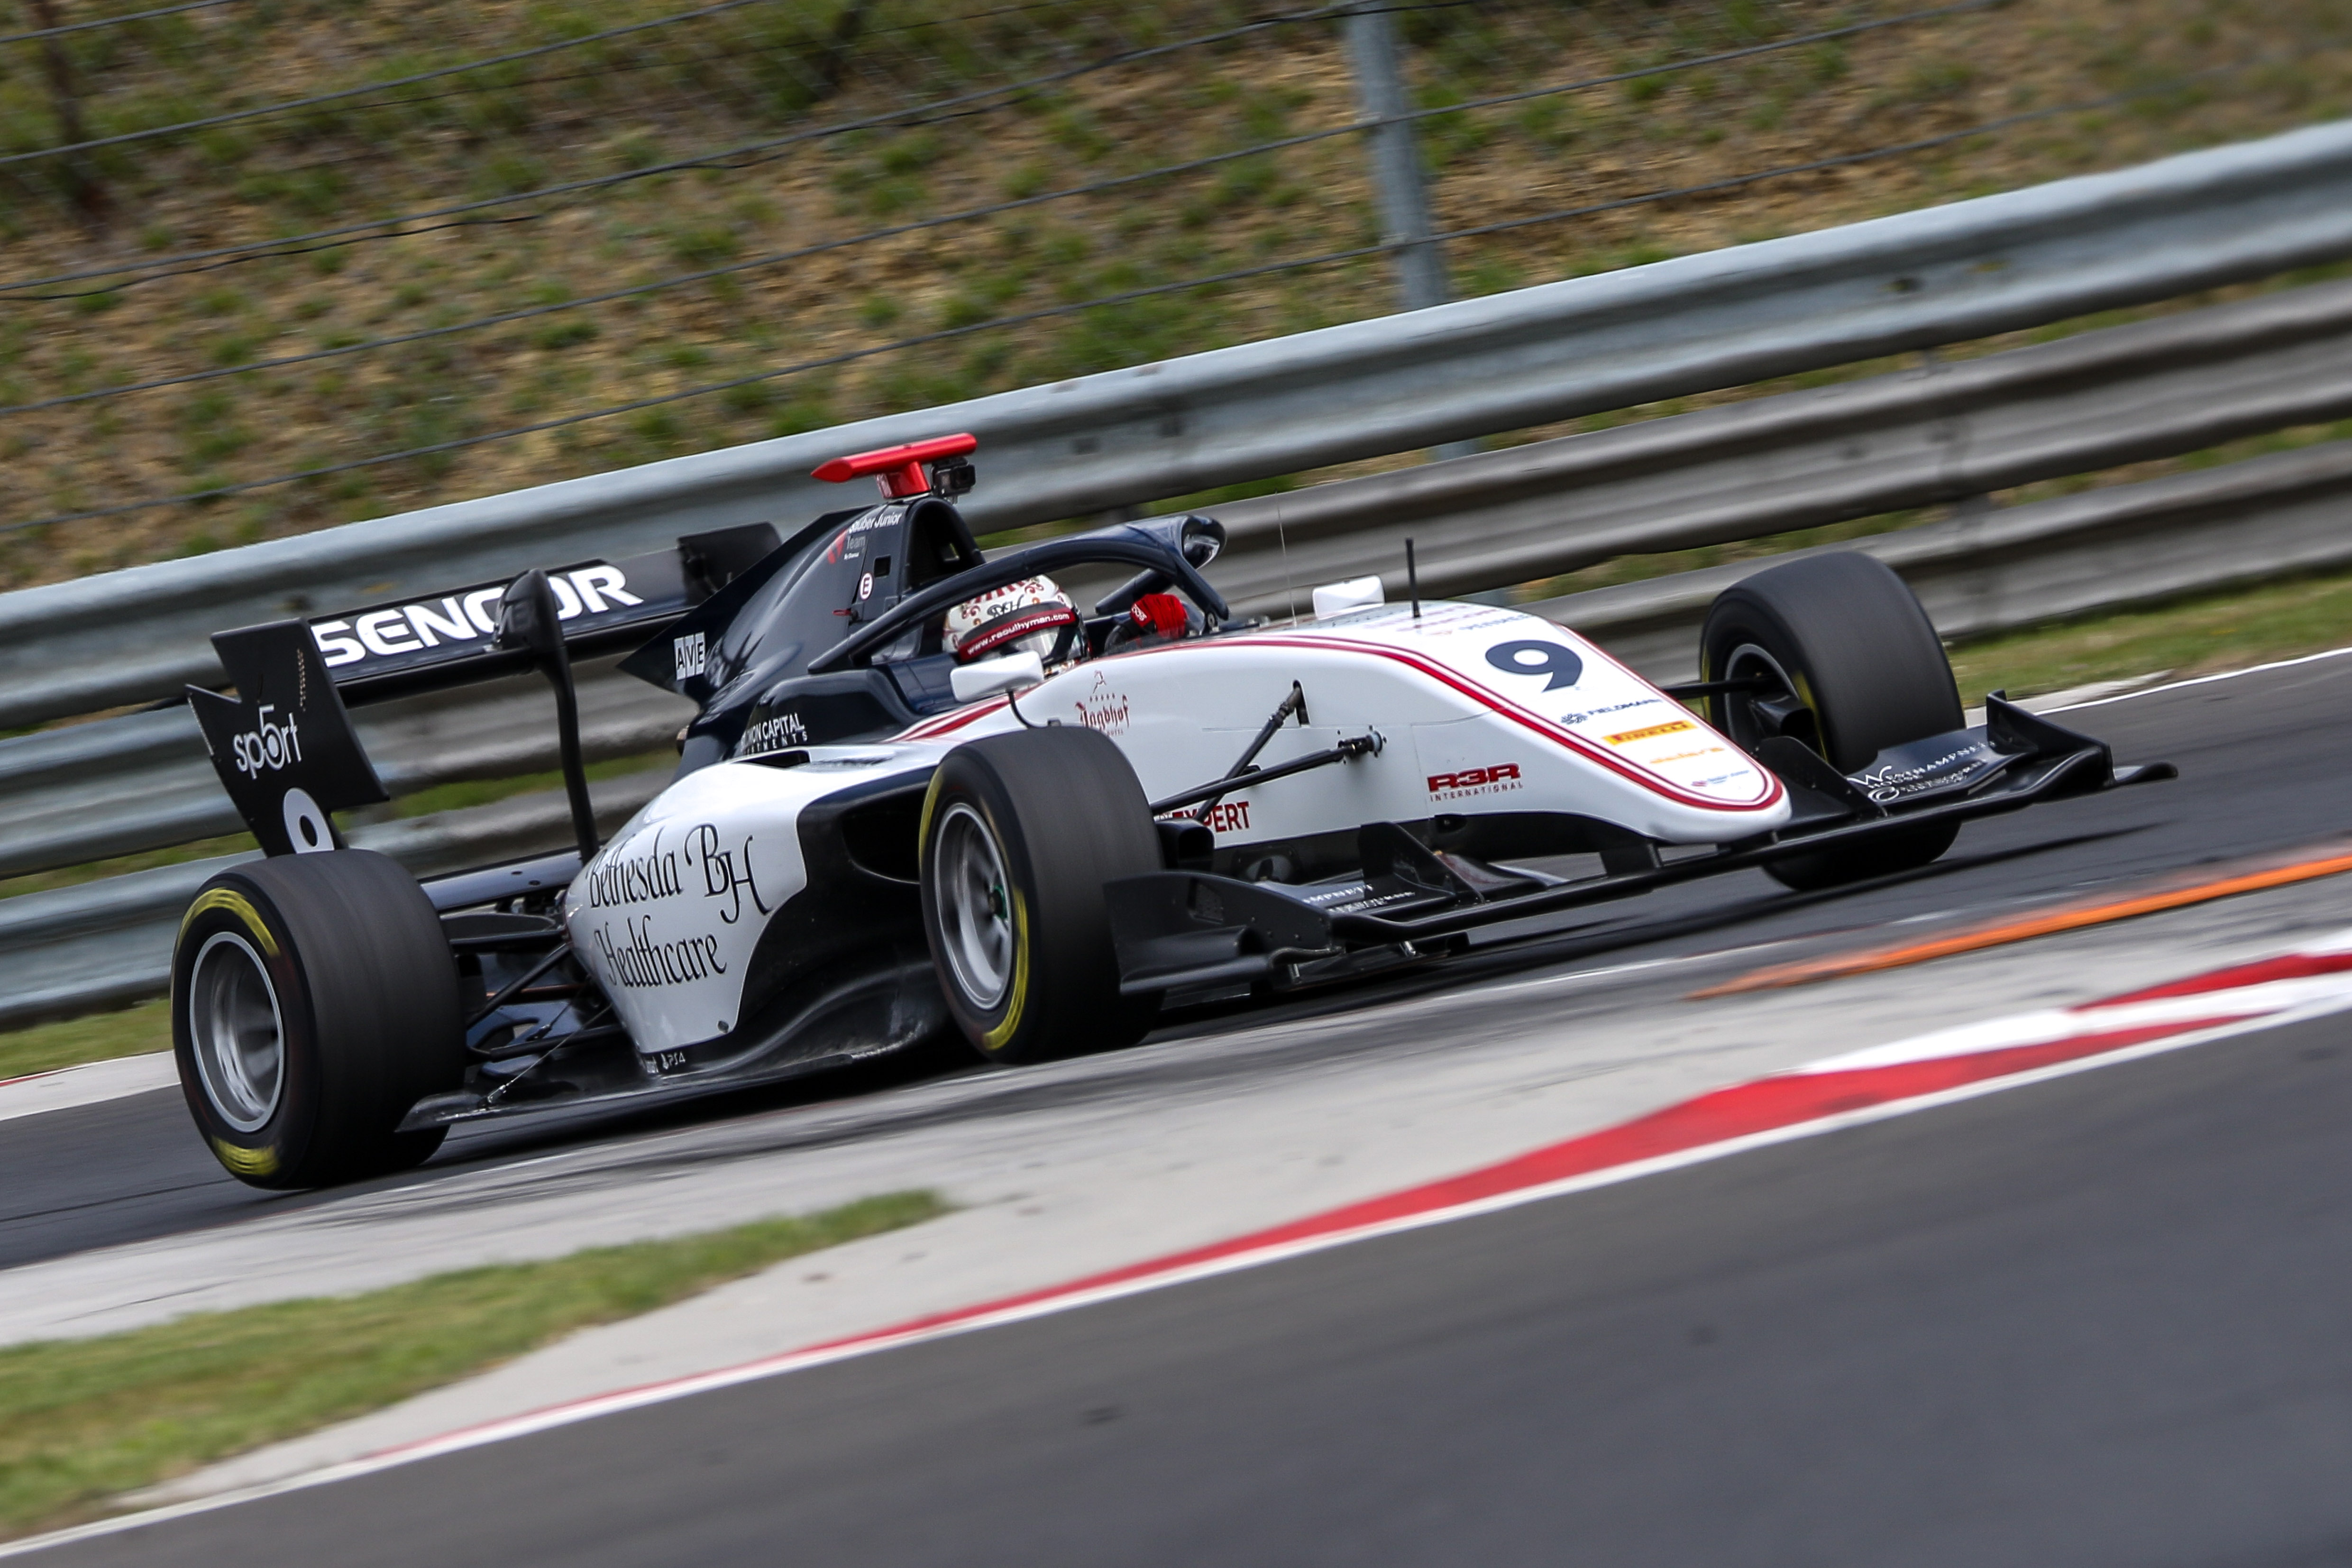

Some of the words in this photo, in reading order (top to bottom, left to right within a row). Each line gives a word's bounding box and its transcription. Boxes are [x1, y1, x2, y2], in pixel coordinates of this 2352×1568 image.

[874, 512, 902, 529] Junior
[846, 535, 867, 551] Team
[967, 613, 1070, 655] www.raoulhyman.com
[676, 640, 704, 670] AVE
[1485, 639, 1583, 693] 9
[762, 712, 805, 740] CAPITAL
[1427, 761, 1521, 792] R3R
[1429, 781, 1524, 803] INTERNATIONAL
[1172, 801, 1250, 833] ERT
[585, 825, 684, 909] Bethesda
[594, 914, 727, 988] Healthcare
